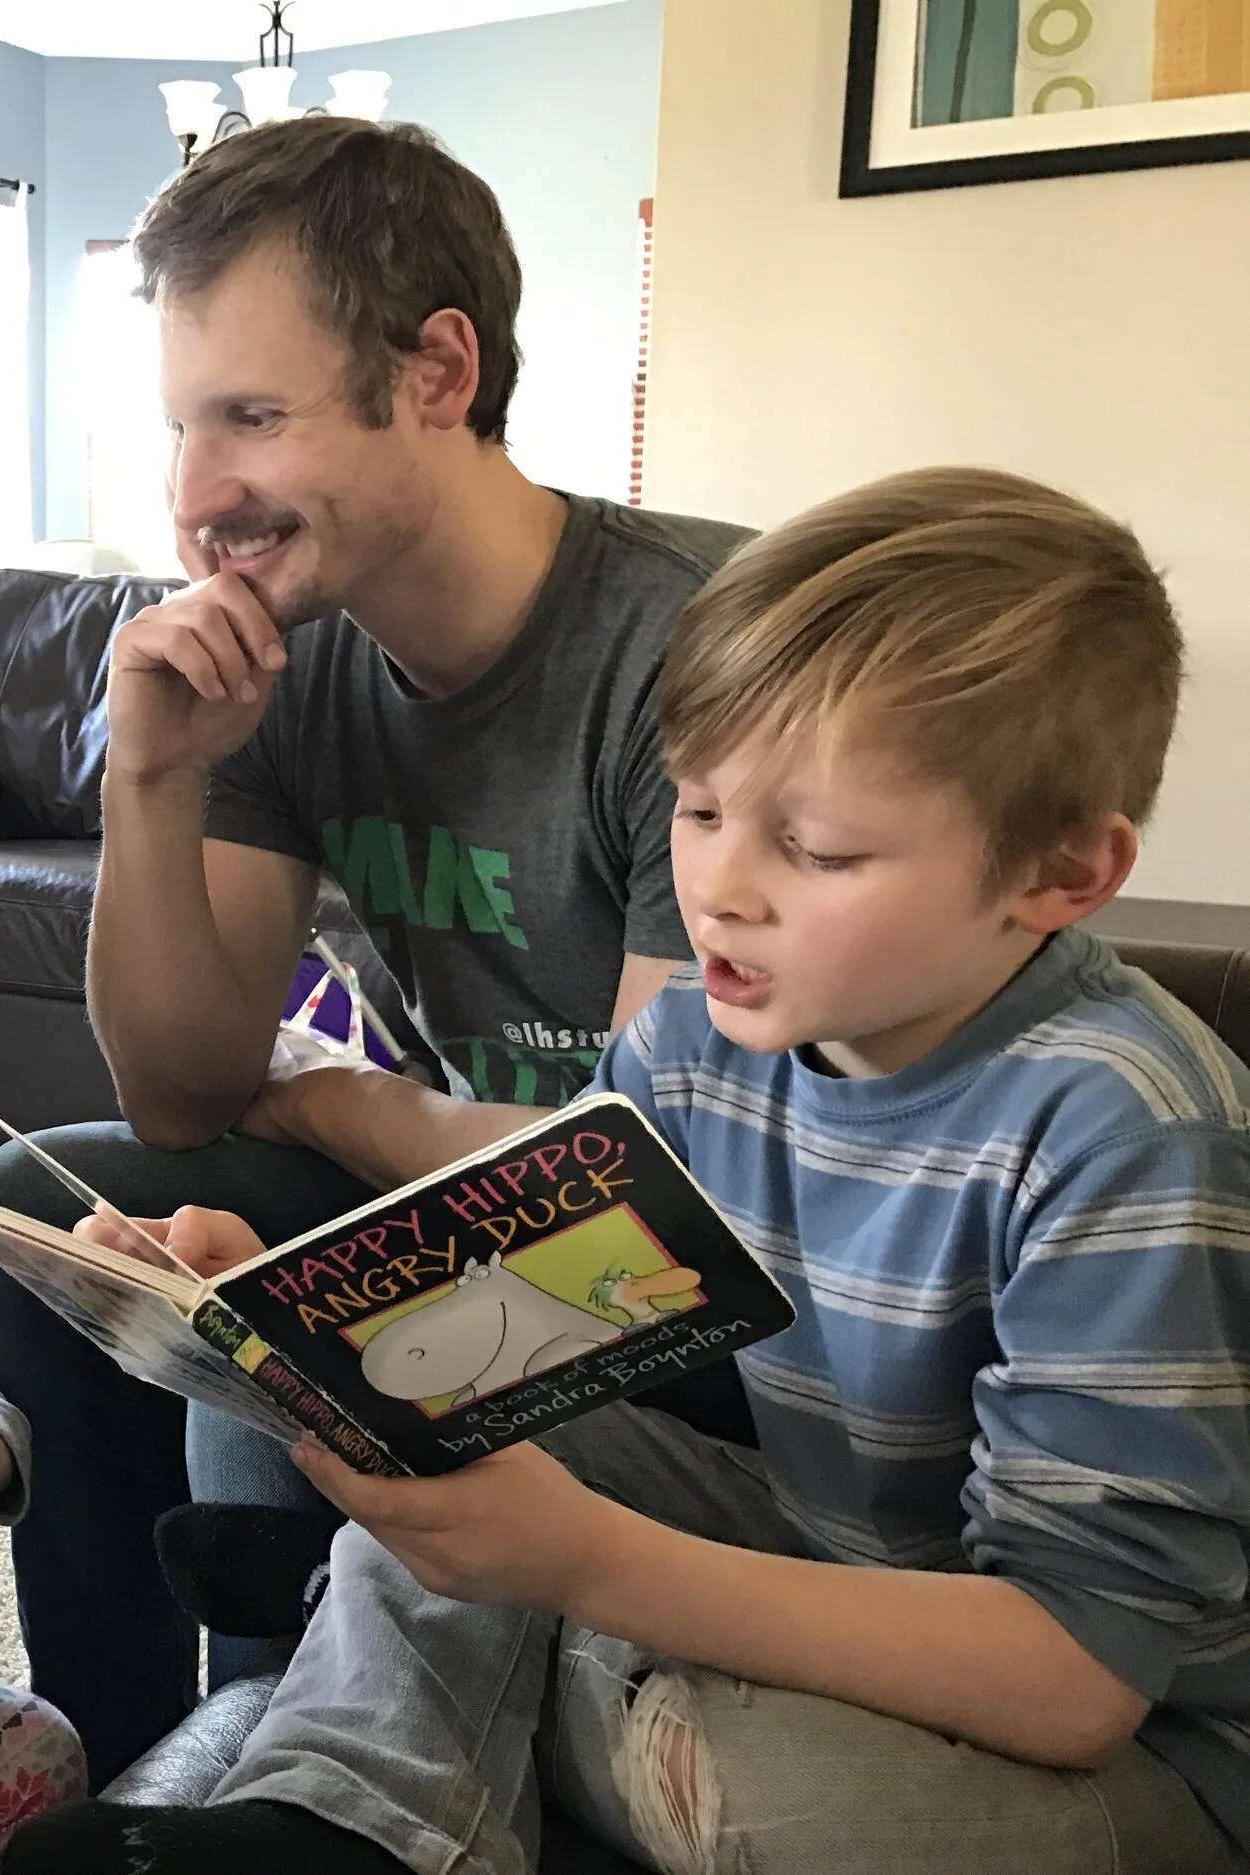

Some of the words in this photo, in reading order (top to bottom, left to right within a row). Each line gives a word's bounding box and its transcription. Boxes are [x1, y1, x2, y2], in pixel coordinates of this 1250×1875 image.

[261, 1208, 424, 1304] HAPPY
[442, 1131, 626, 1222] HIPPO,
[297, 1235, 456, 1335] ANGRY
[470, 1158, 634, 1250] DUCK
[259, 1357, 301, 1401] HAPPY
[331, 1422, 369, 1461] ANGRY
[437, 1431, 492, 1454] by
[483, 1382, 608, 1436] Sandra
[599, 1318, 752, 1386] Boynton
[465, 1410, 483, 1424] a
[484, 1378, 557, 1413] book
[563, 1360, 593, 1382] of
[596, 1321, 691, 1364] moods
